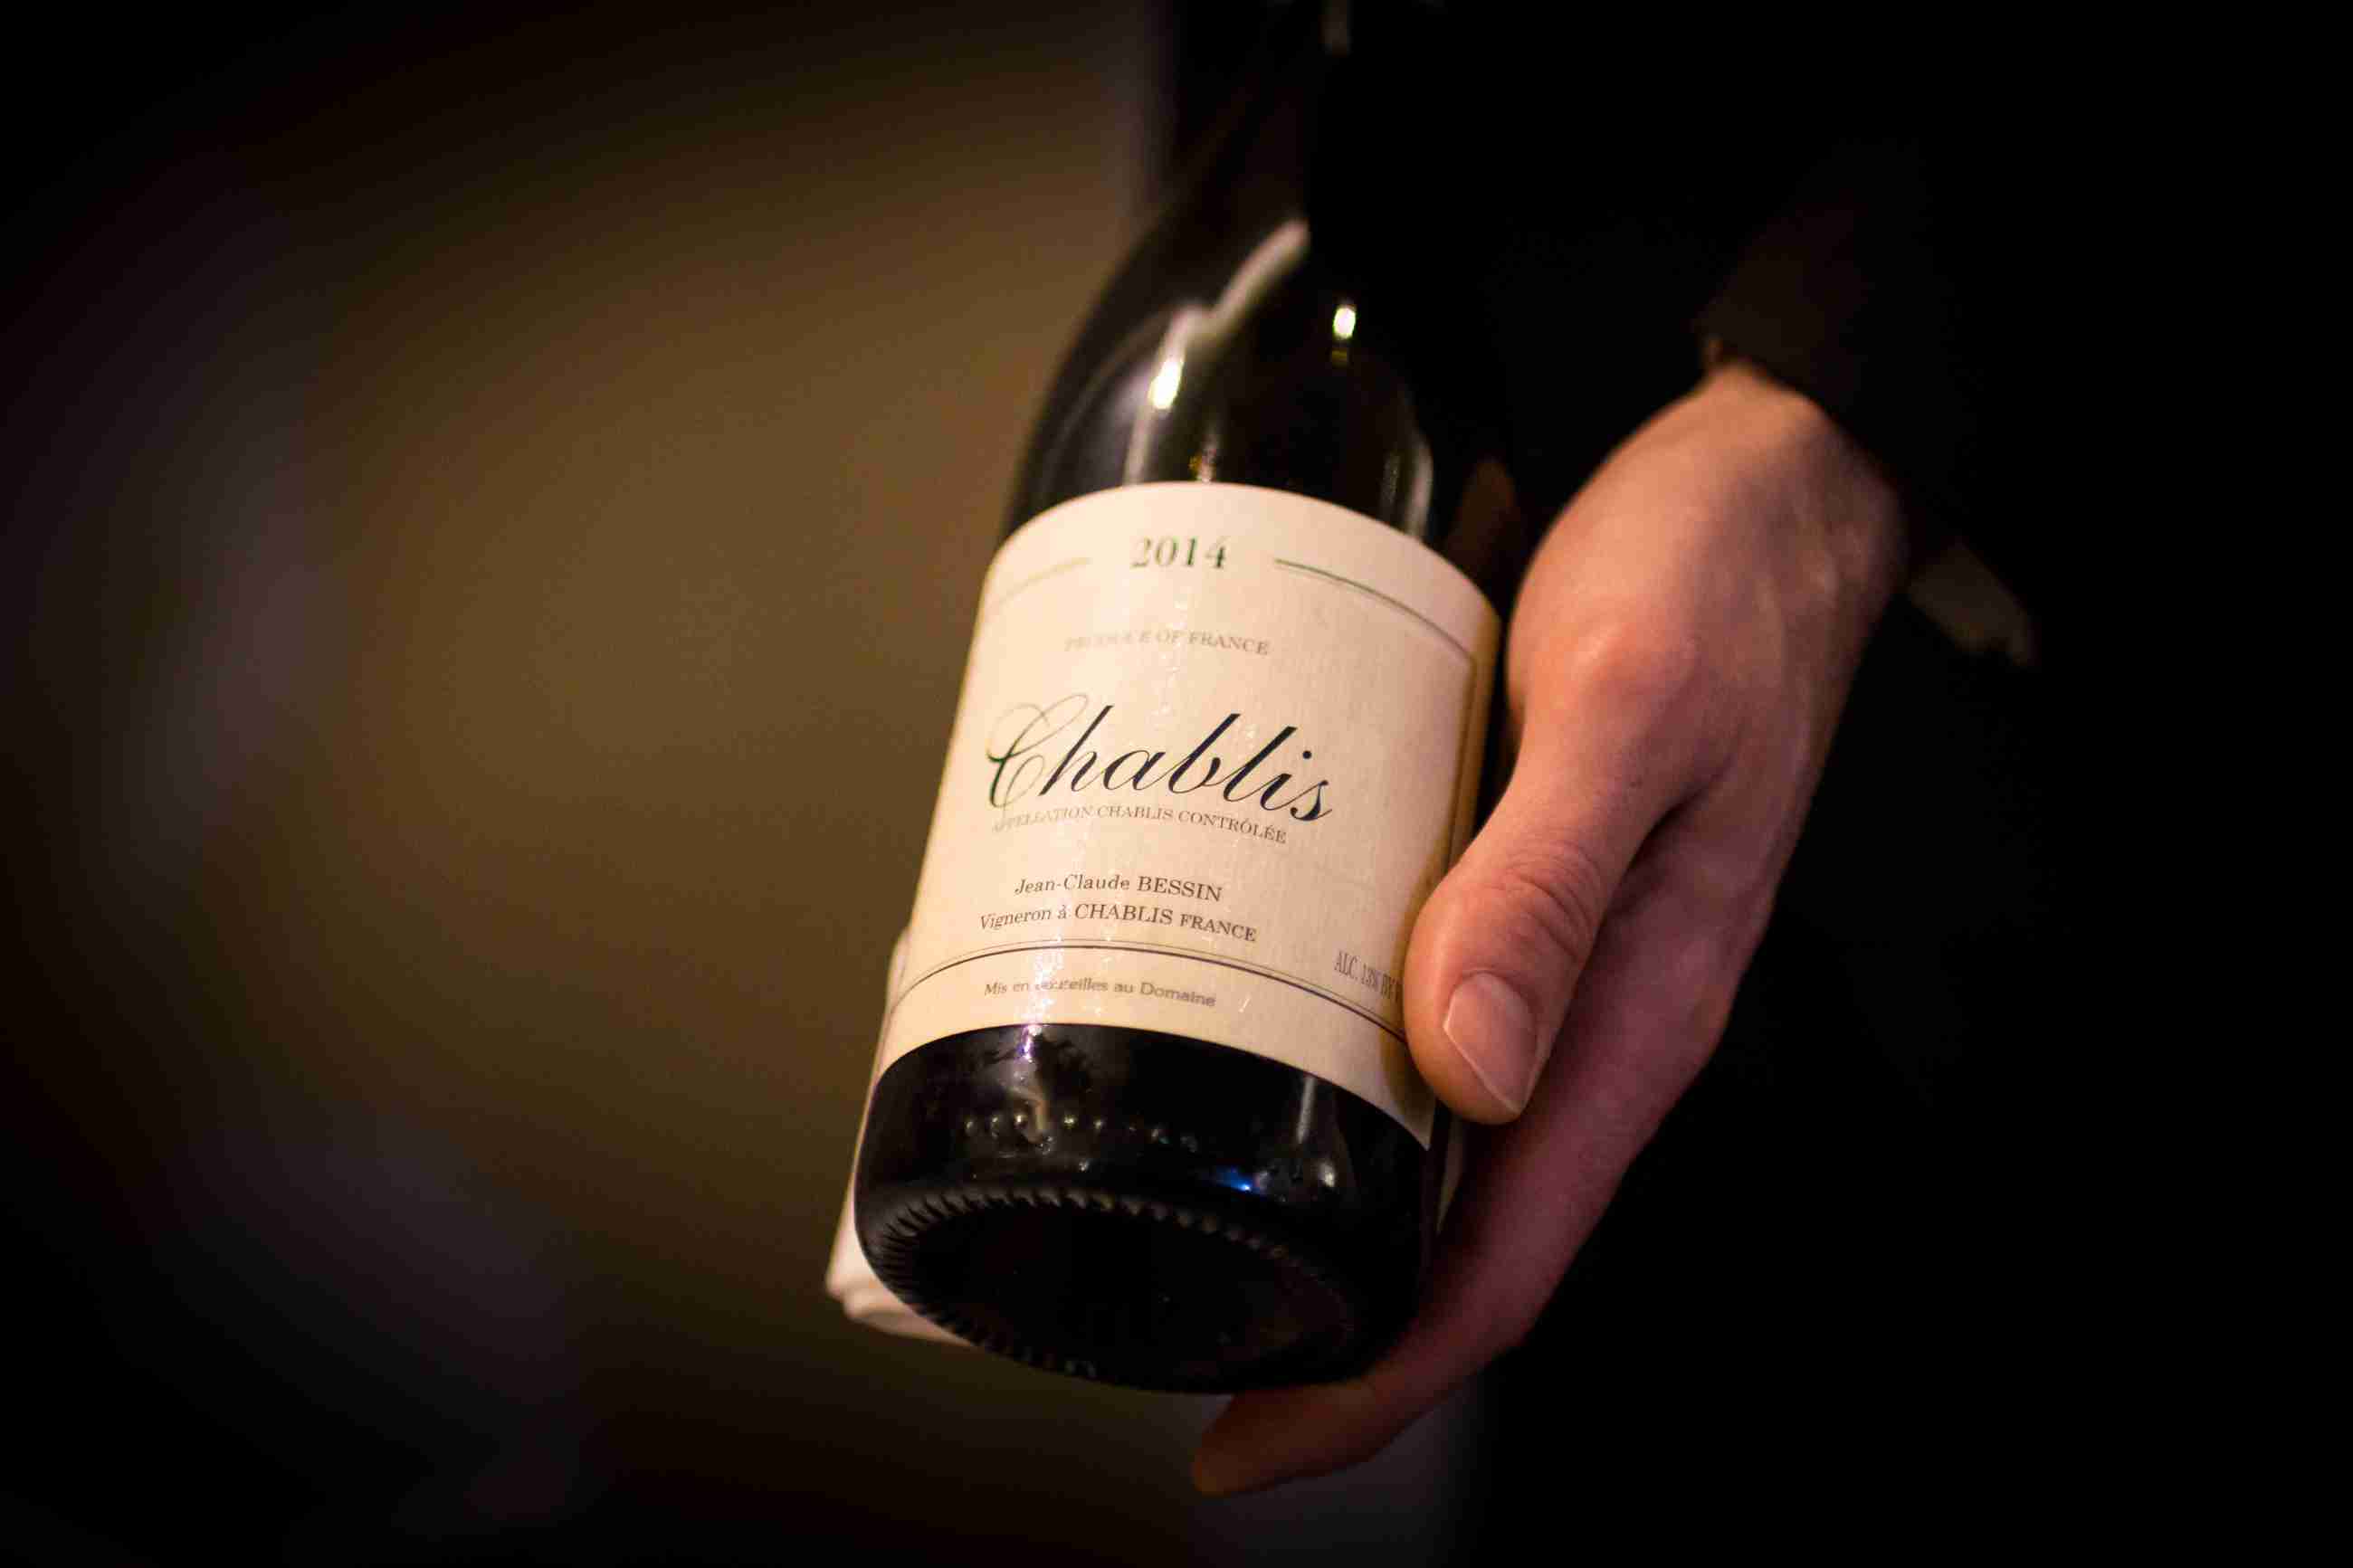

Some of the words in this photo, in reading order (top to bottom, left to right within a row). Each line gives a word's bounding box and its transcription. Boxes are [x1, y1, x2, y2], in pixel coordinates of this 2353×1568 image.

[1130, 536, 1228, 570] 2014
[1156, 630, 1184, 645] OF
[1187, 631, 1269, 656] FRANCE
[986, 693, 1333, 822] Chablis
[1096, 804, 1175, 821] CHABLIS
[1014, 873, 1130, 895] Jean-Claude
[1137, 875, 1224, 903] BESSIN
[979, 908, 1052, 930] Vigneron
[1057, 904, 1068, 919] à
[1074, 902, 1174, 925] CHABLIS
[1179, 912, 1258, 942] FRANCE
[984, 981, 1008, 995] Mis
[1013, 980, 1030, 993] en
[1034, 976, 1110, 993] outeilles
[1114, 982, 1135, 994] au
[1138, 981, 1217, 1007] Domaine
